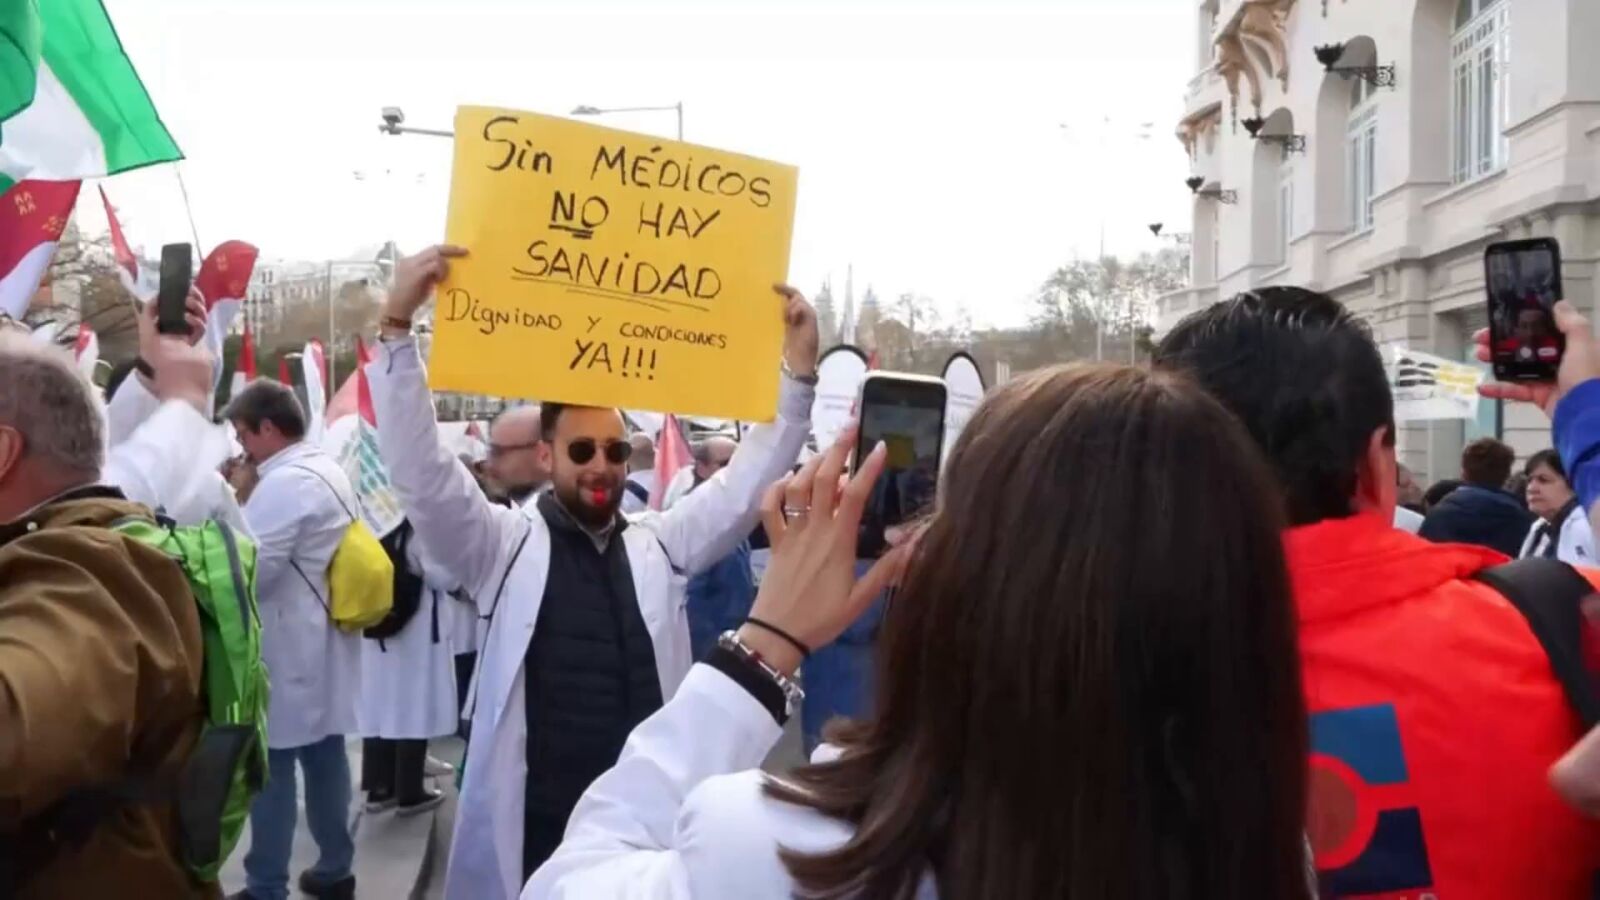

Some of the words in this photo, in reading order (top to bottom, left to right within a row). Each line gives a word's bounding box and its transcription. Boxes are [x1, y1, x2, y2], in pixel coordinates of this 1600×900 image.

[482, 115, 553, 174] Sin
[550, 189, 610, 229] NO
[637, 201, 721, 239] HAY
[586, 315, 602, 334] Y
[568, 338, 656, 381] YA!!!
